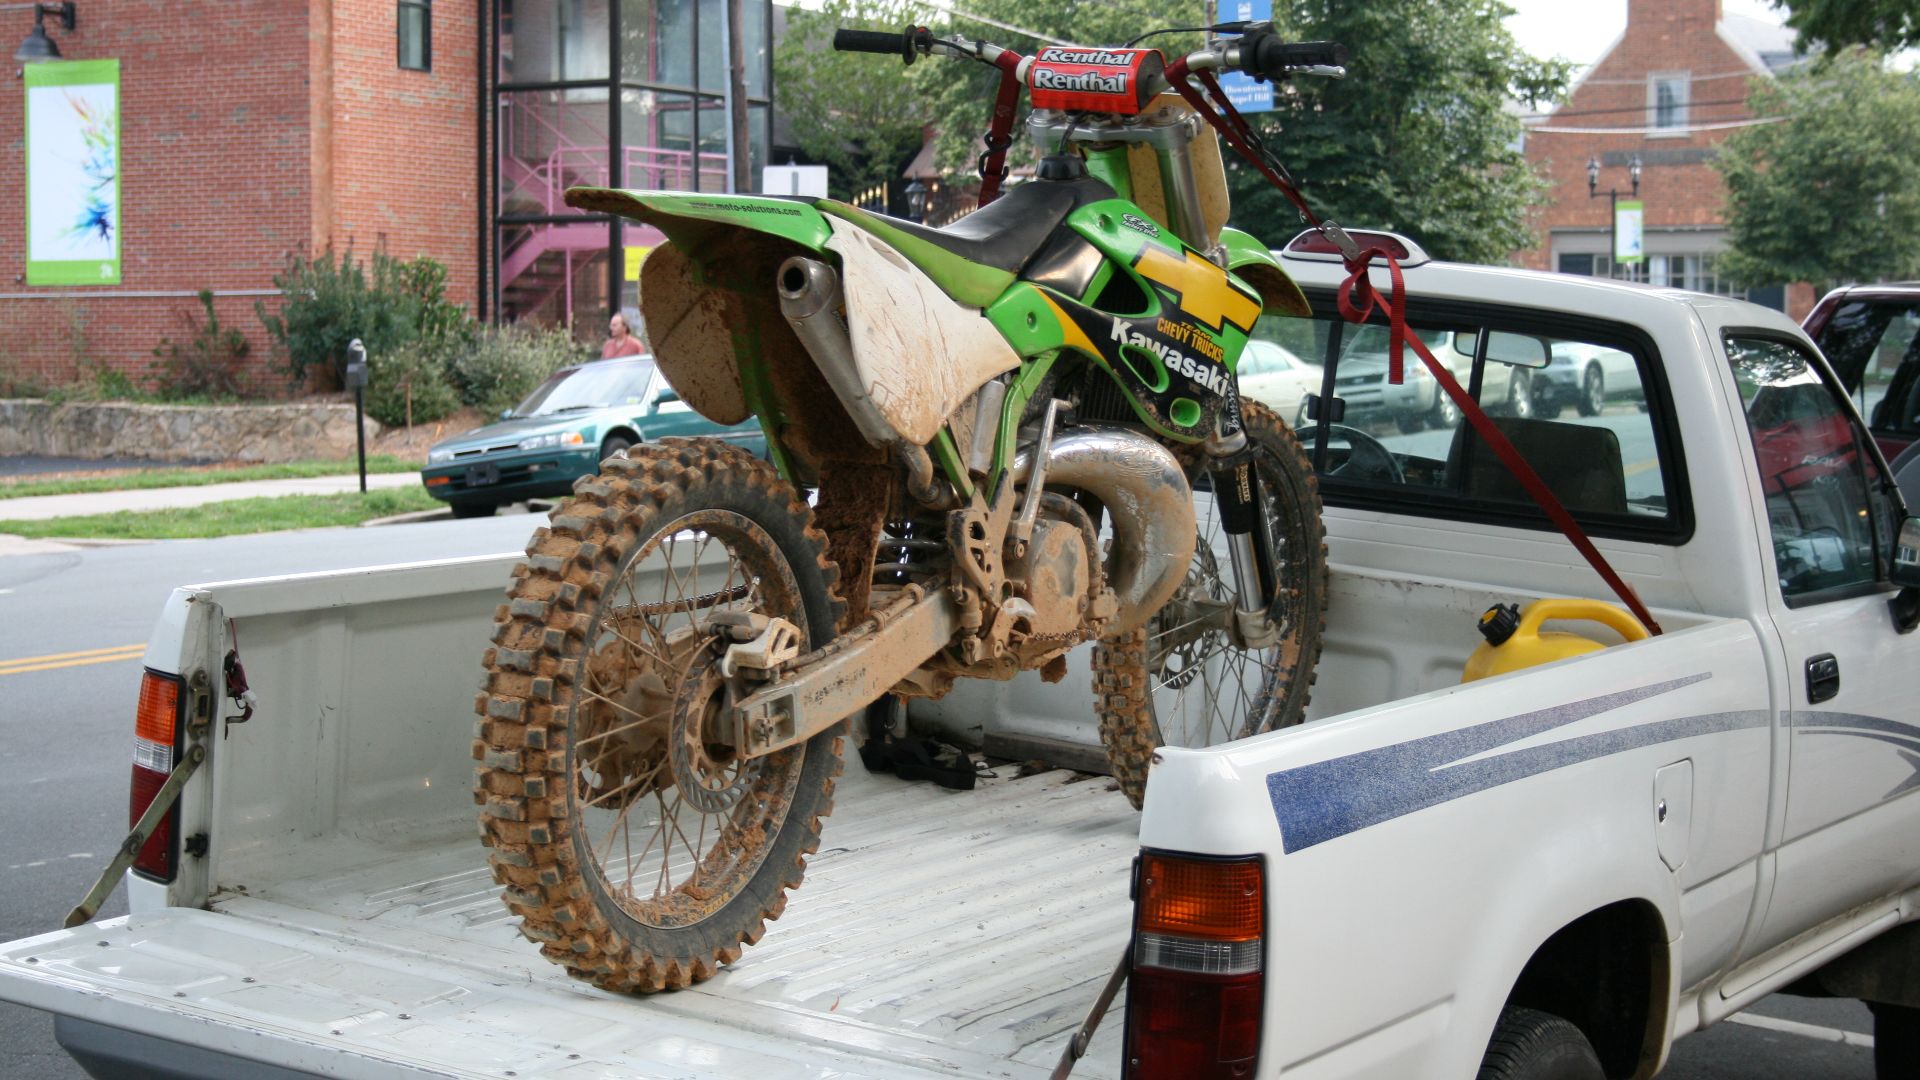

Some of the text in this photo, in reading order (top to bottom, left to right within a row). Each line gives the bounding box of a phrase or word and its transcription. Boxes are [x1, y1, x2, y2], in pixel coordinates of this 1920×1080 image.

[1039, 49, 1136, 66] Renthal
[1034, 69, 1127, 93] Renthal
[1157, 317, 1224, 363] CHEVY TRUCKS
[1181, 321, 1213, 341] TEAM
[1110, 317, 1230, 397] Kawasaki
